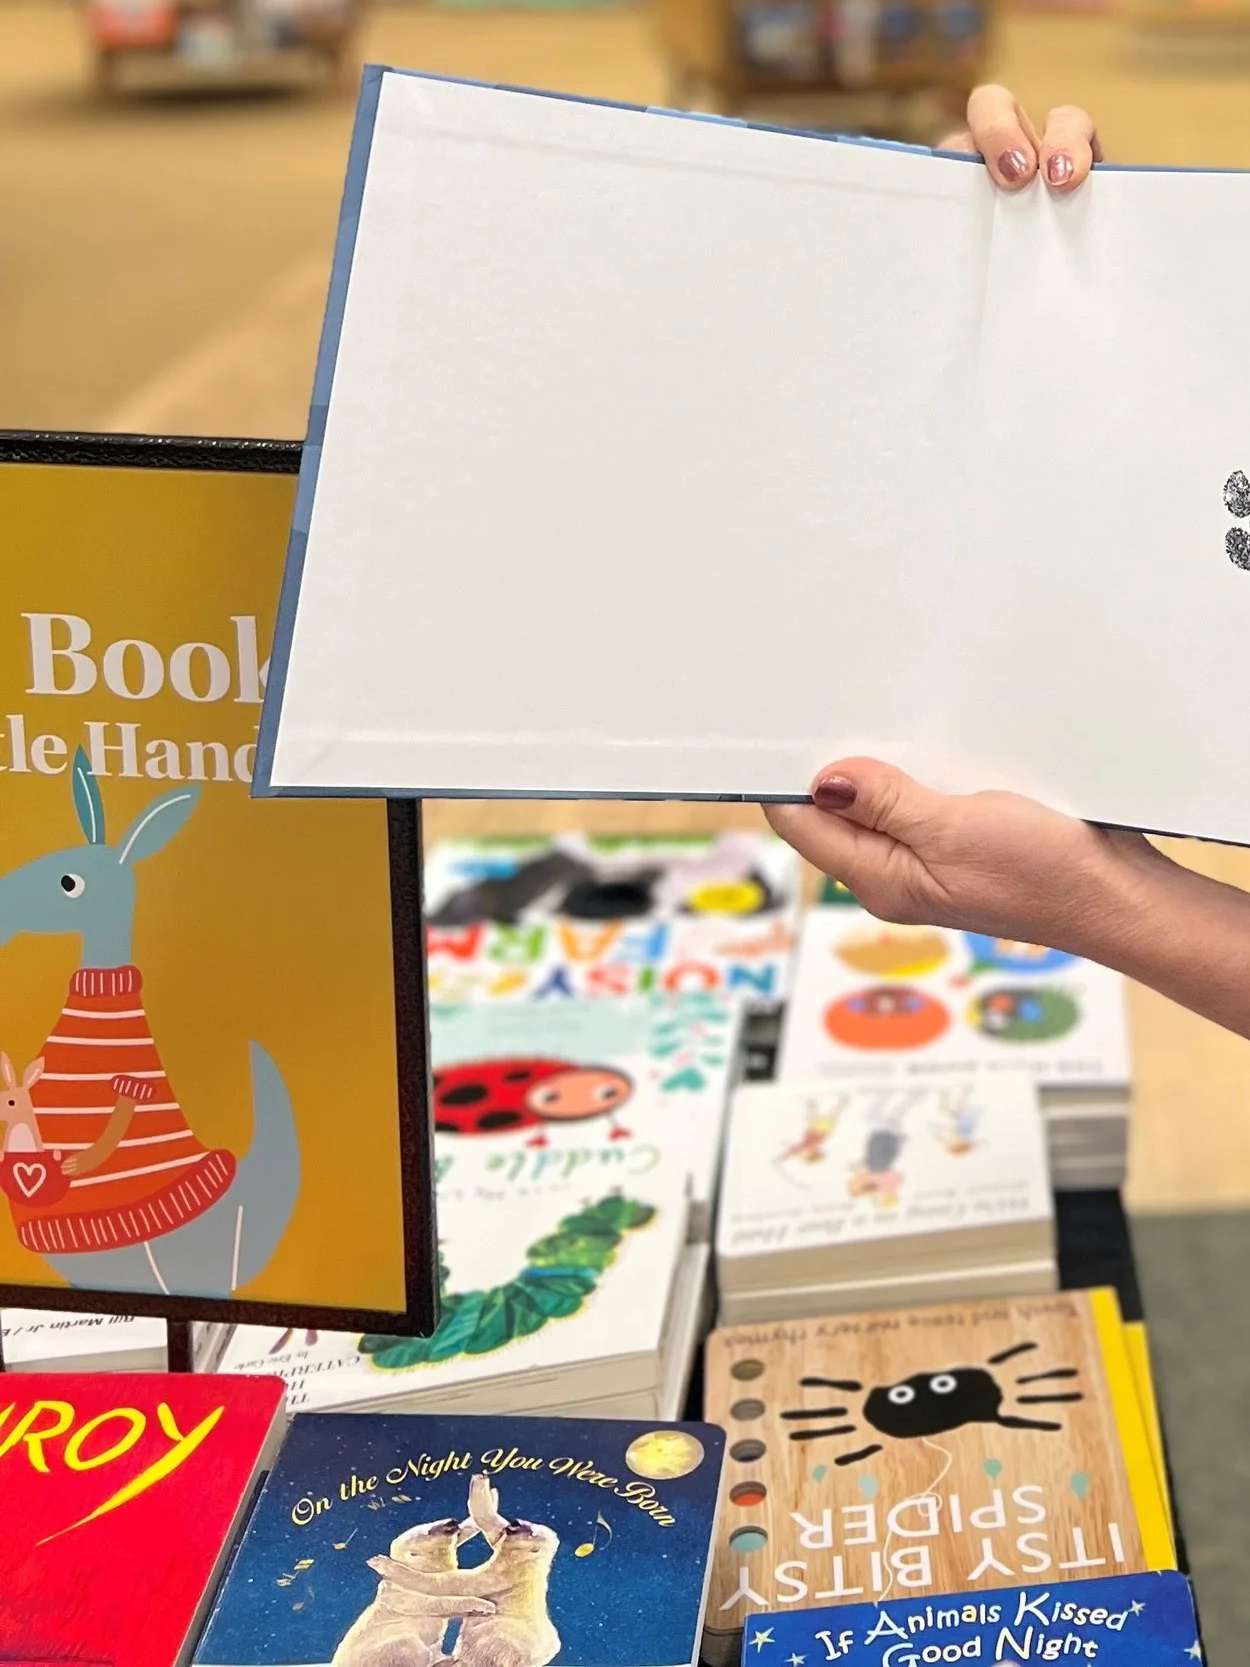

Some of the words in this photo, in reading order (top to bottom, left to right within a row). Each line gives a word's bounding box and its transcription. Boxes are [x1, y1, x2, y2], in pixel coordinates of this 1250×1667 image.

[50, 1318, 104, 1330] Martin
[291, 1496, 333, 1526] On
[340, 1474, 379, 1500] the
[386, 1450, 473, 1483] Night
[480, 1447, 543, 1475] You
[549, 1456, 618, 1488] Were
[614, 1477, 678, 1528] Born
[789, 1485, 1046, 1550] SPIDER
[720, 1545, 932, 1611] BITSY
[968, 1522, 1127, 1580] ITSY
[815, 1629, 854, 1662] If
[864, 1603, 1002, 1646] Animals
[1014, 1590, 1128, 1631] Kissed
[882, 1635, 982, 1667] Good
[995, 1625, 1099, 1662] Night
